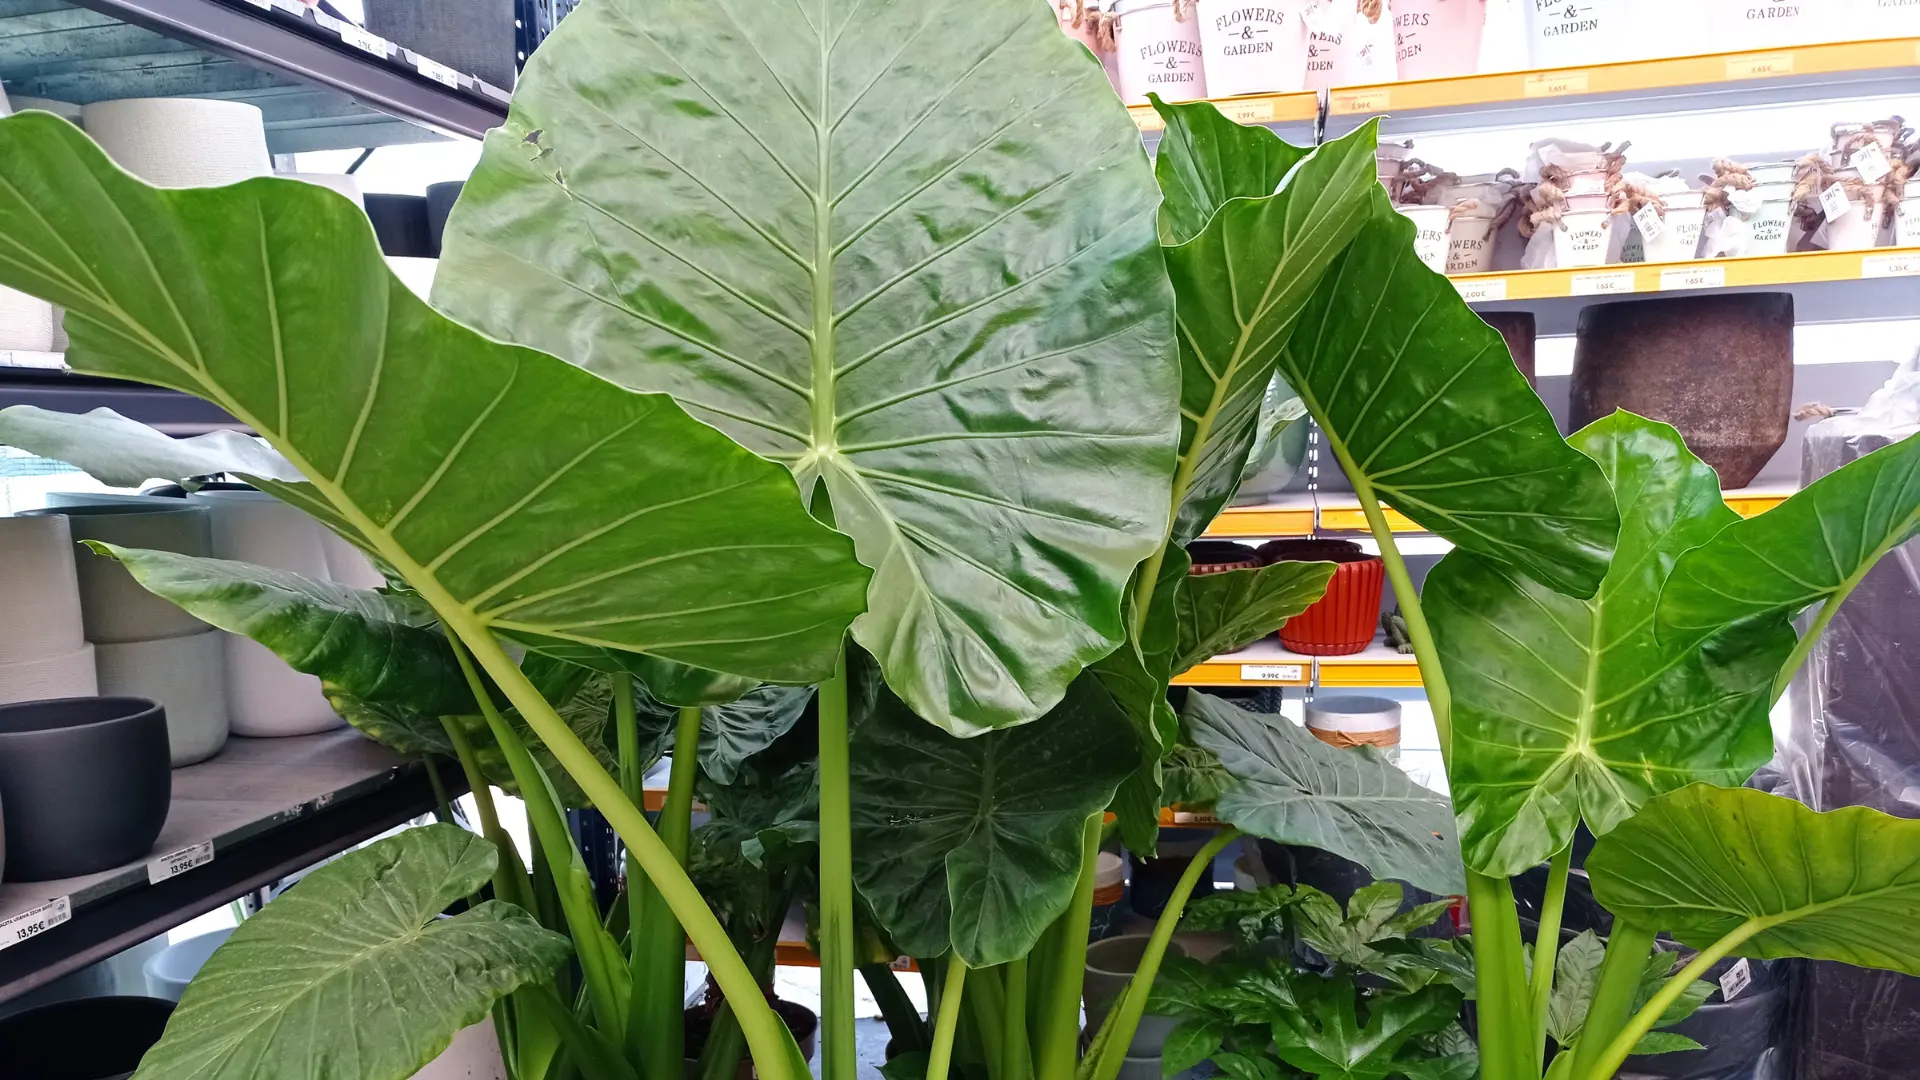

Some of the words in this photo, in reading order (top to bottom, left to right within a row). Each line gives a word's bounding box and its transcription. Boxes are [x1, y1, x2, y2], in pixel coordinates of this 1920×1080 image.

[1564, 5, 1577, 18] &
[1746, 5, 1800, 20] GARDEN
[1216, 7, 1284, 31] FLOWERS
[1241, 26, 1254, 40] &
[1543, 19, 1598, 36] GARDEN
[1140, 40, 1202, 60] FLOWERS
[1223, 42, 1273, 56] GARDEN
[1165, 57, 1178, 69] &
[1148, 72, 1194, 83] GARDEN
[1753, 219, 1785, 230] FLOWERS
[1755, 232, 1782, 240] GARDEN
[170, 860, 193, 875] 13,95€
[16, 920, 45, 940] 13,95€
